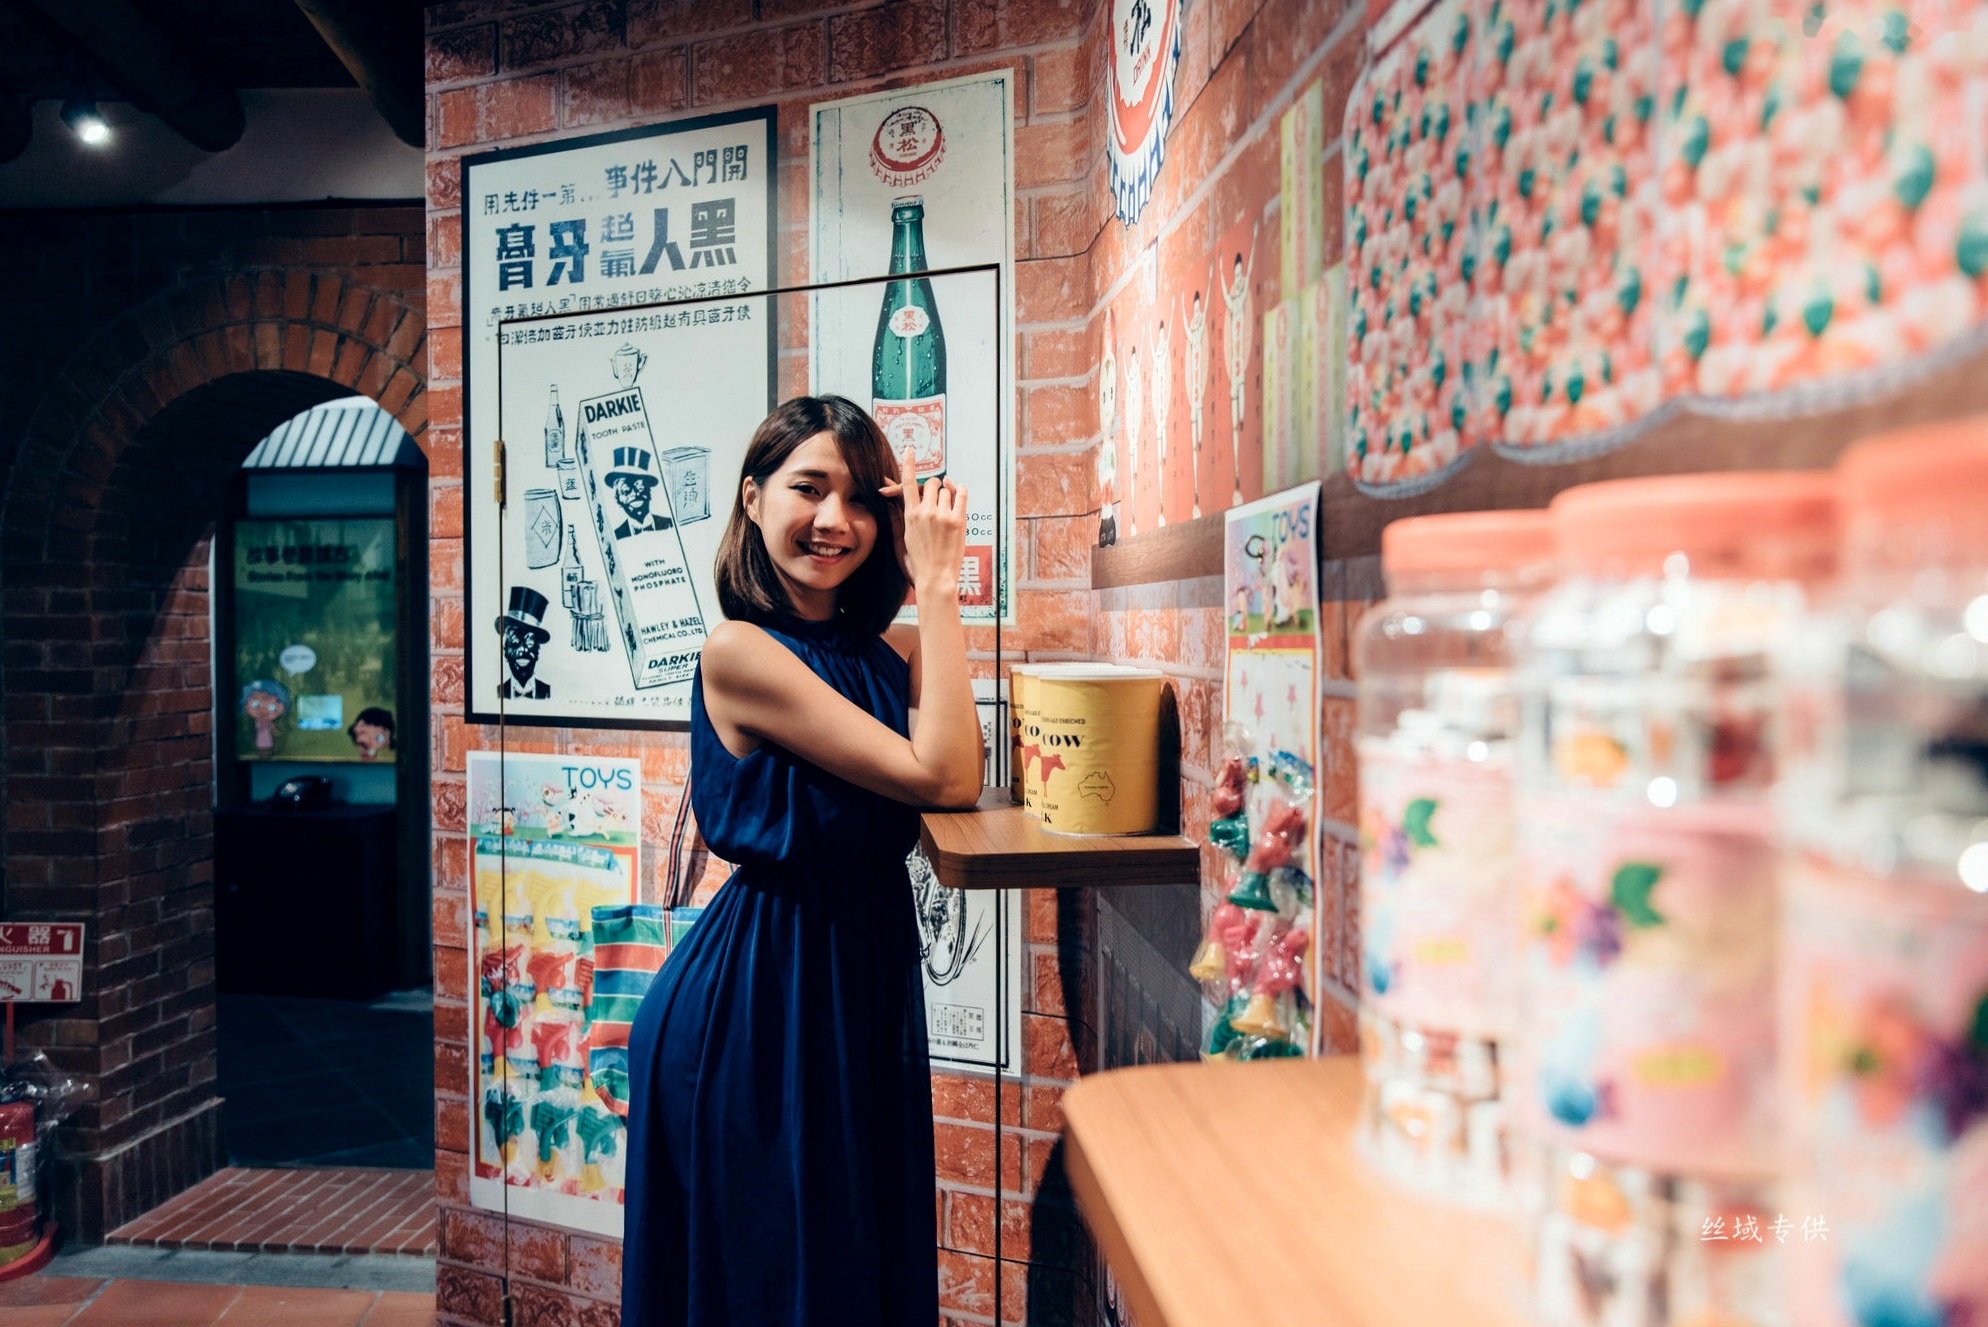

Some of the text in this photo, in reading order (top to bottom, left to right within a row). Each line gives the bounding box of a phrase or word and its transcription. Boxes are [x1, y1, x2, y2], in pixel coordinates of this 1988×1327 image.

[584, 394, 640, 423] DARKIE
[592, 421, 646, 440] TOOTH PASTE
[1272, 503, 1310, 547] TOYS
[643, 558, 666, 568] WITH
[631, 567, 683, 583] MONOFLUORO
[634, 576, 687, 592] PHOSPHATE
[957, 556, 981, 596] 黑
[641, 616, 702, 636] HAWLEY & HAZEL
[643, 632, 676, 645] CHEMICAL
[1024, 725, 1040, 737] CO
[561, 766, 632, 791] TOYS
